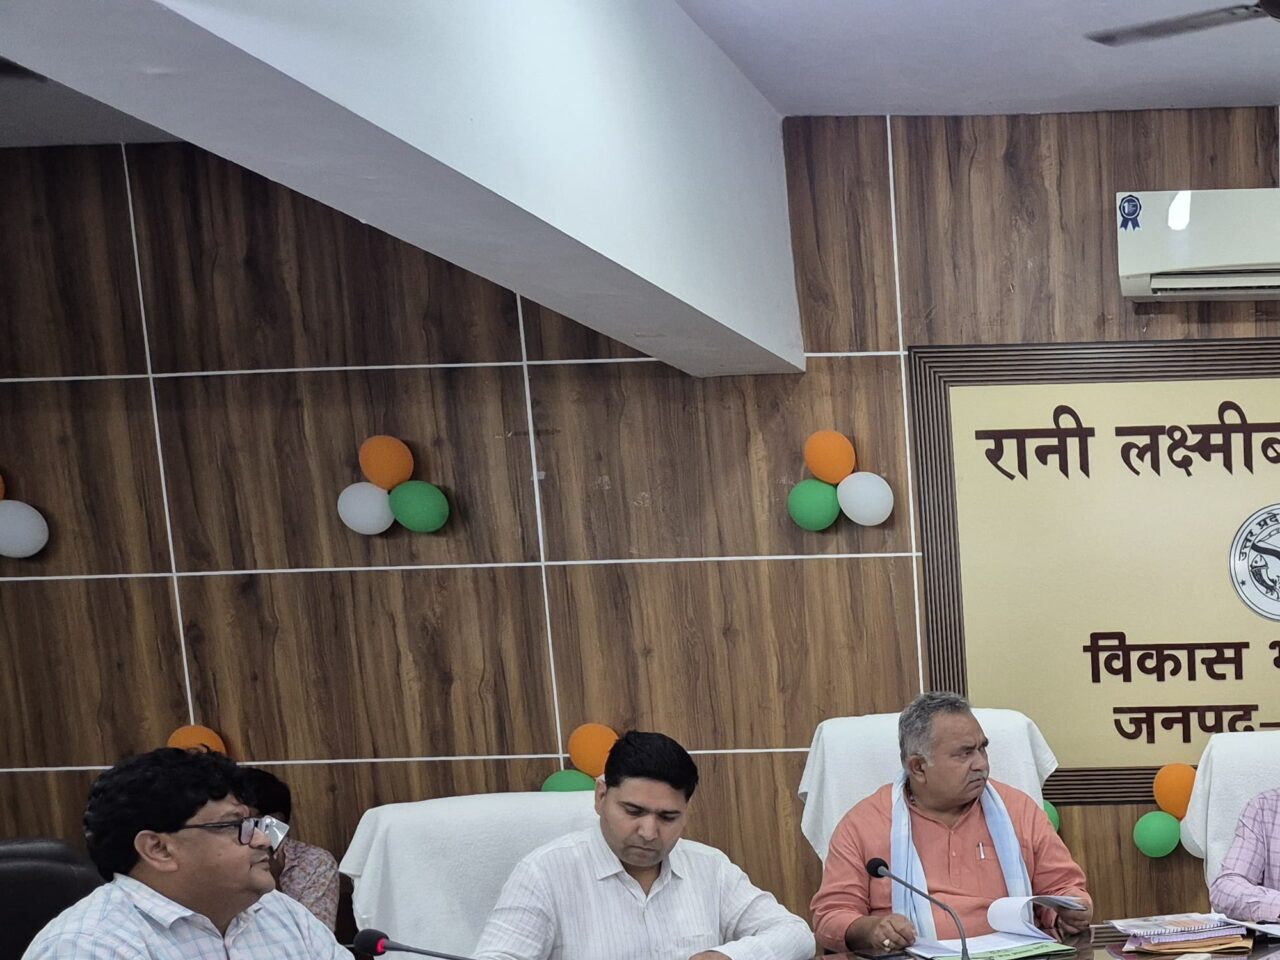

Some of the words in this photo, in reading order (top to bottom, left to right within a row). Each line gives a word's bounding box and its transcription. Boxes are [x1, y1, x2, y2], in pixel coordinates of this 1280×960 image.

[975, 405, 1095, 480] रानी
[1239, 528, 1257, 562] उत्तर
[1083, 632, 1249, 683] विकास
